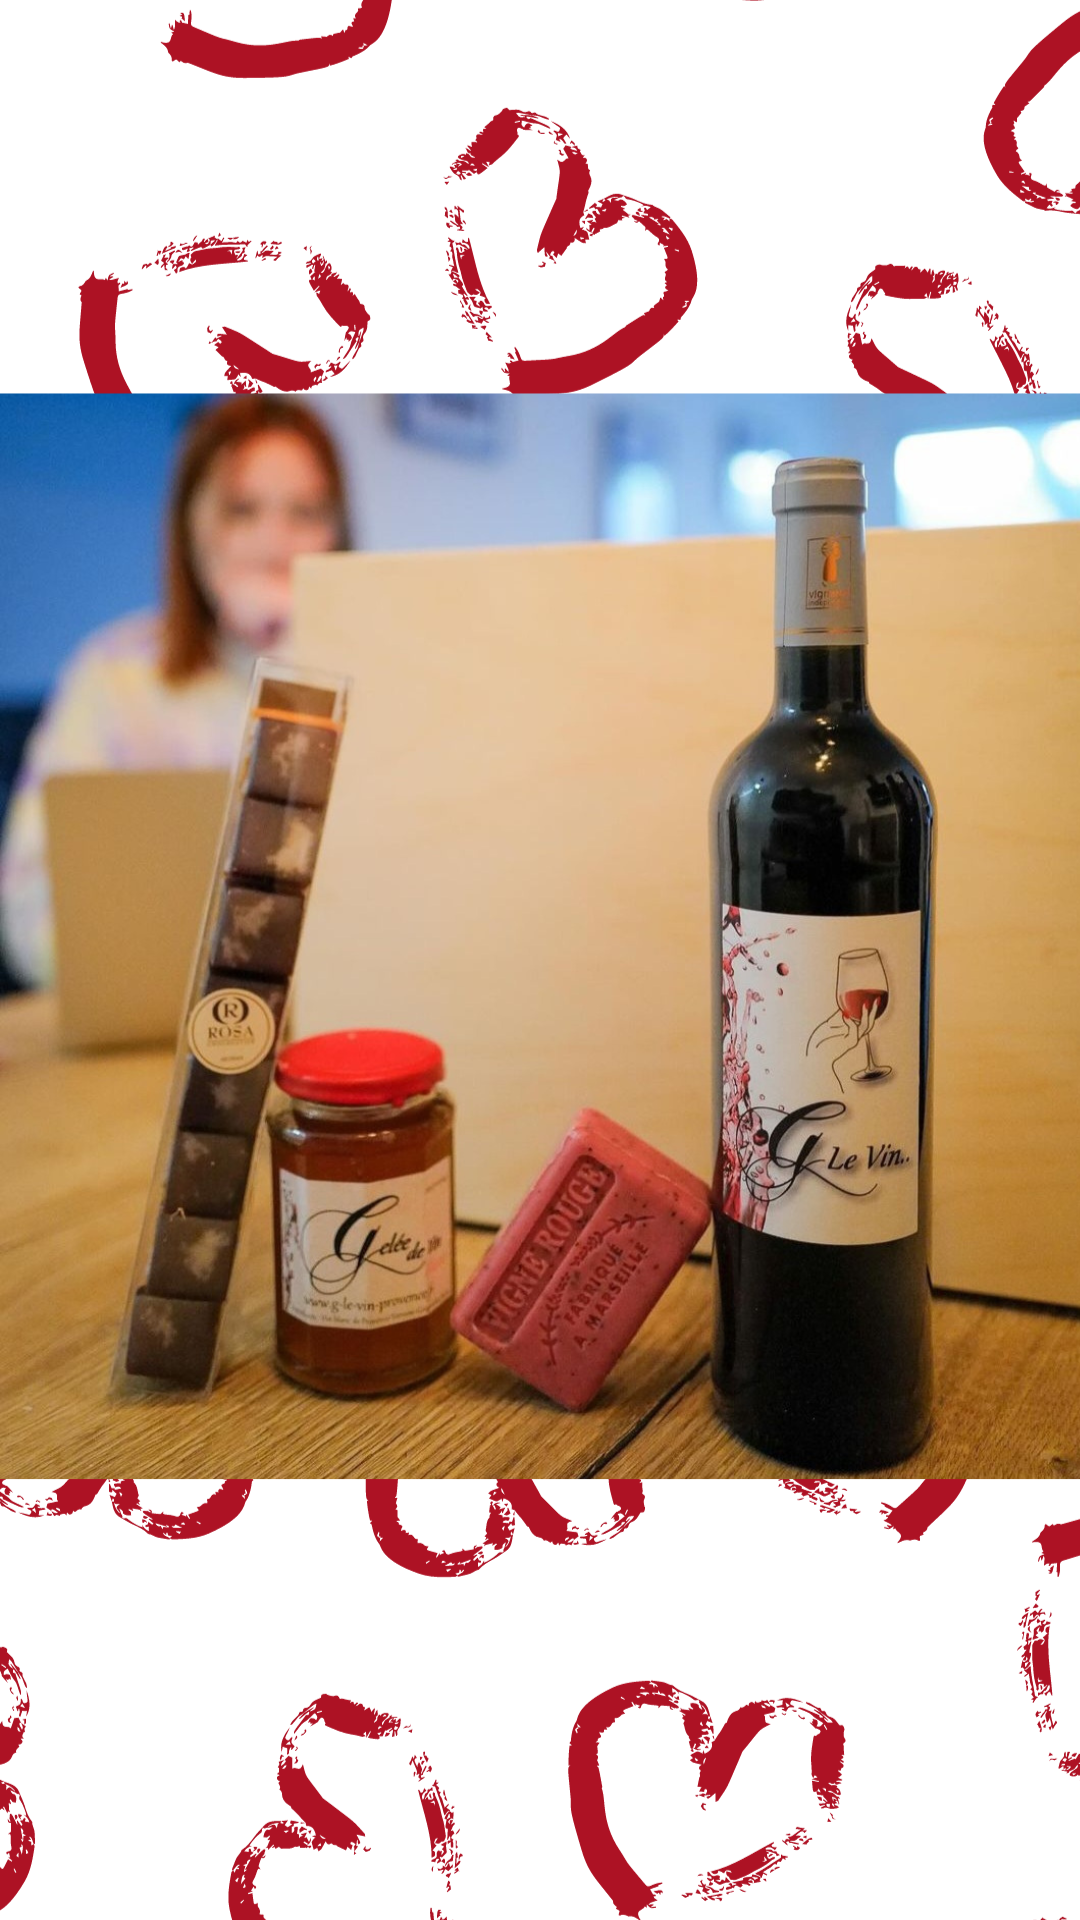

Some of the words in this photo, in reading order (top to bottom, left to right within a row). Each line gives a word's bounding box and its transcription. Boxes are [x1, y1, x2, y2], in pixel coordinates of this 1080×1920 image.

[208, 1025, 255, 1039] ROSA
[736, 1100, 878, 1202] G
[827, 1146, 859, 1171] Le
[406, 1240, 426, 1262] de
[481, 1251, 549, 1332] VIGNE
[533, 1162, 607, 1258] ROUGE
[573, 1335, 588, 1350] A
[584, 1241, 649, 1331] MARSEILLE
